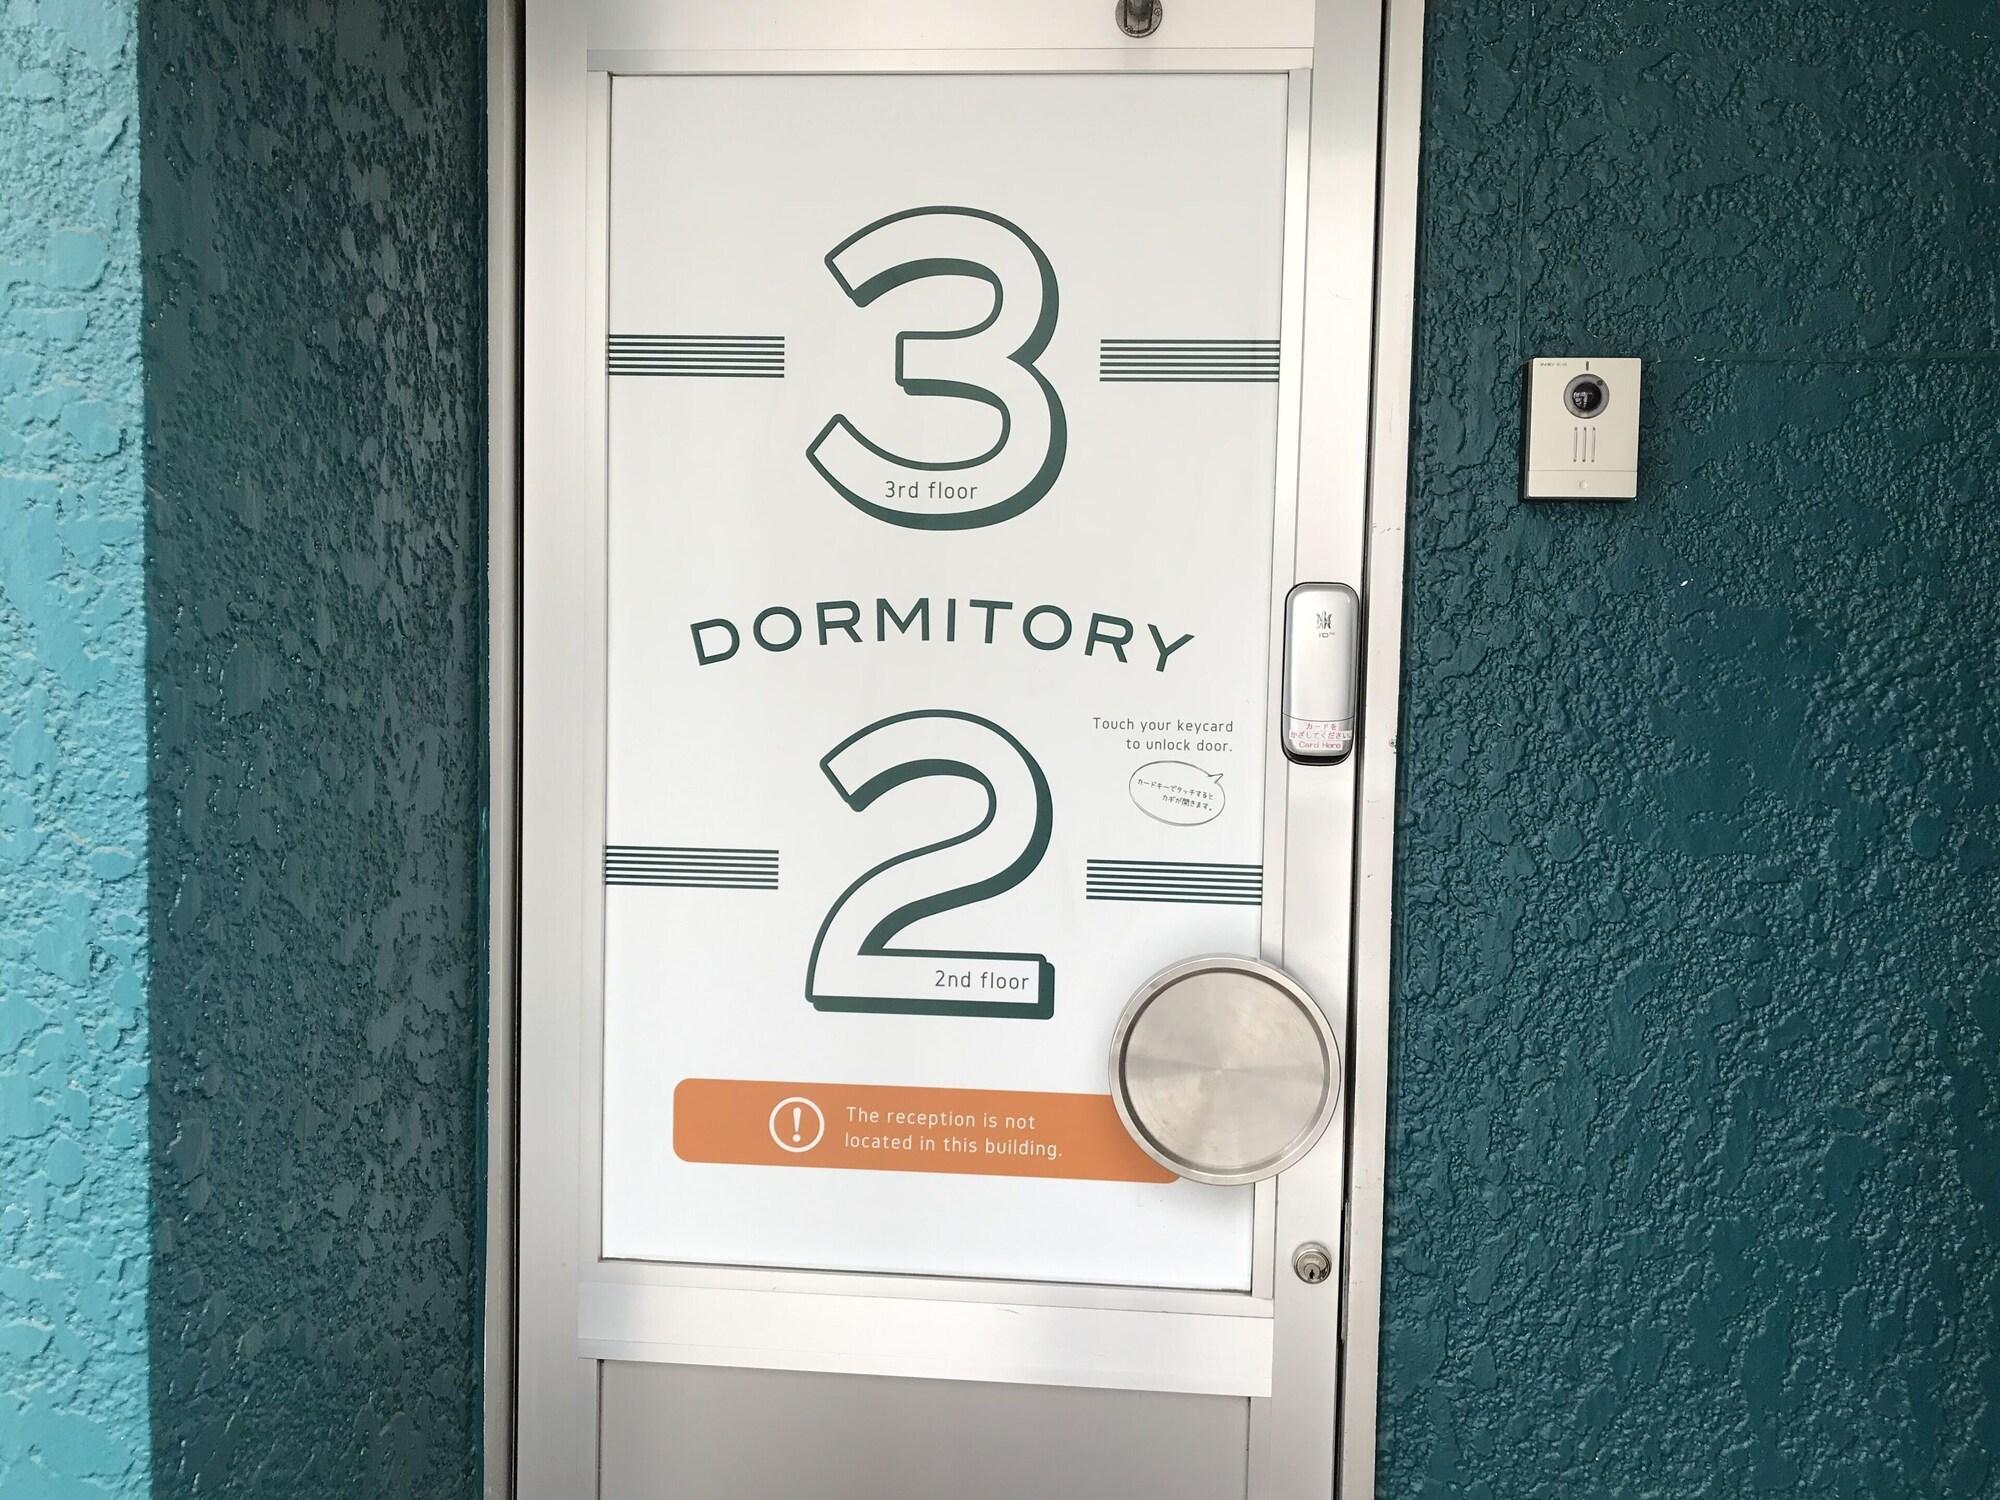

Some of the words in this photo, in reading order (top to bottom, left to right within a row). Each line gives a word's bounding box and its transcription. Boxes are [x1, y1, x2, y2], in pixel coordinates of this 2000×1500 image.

[806, 205, 1067, 532] 3
[884, 480, 919, 499] 3rd
[928, 481, 978, 500] floor
[690, 597, 1195, 673] DORMITORY
[1092, 716, 1135, 730] Touch
[1140, 721, 1172, 733] your
[1177, 719, 1233, 735] keycard
[1126, 738, 1141, 750] to
[1146, 738, 1191, 751] unlock
[1196, 739, 1233, 752] door.
[805, 709, 1056, 1021] 2
[935, 969, 971, 988] 2nd
[980, 971, 1030, 990] floor
[846, 1106, 880, 1123] The
[887, 1111, 976, 1129] reception
[983, 1112, 998, 1128] is
[1005, 1115, 1036, 1130] not
[844, 1131, 913, 1150] located
[920, 1135, 935, 1151] in
[943, 1135, 978, 1153] this
[985, 1137, 1063, 1161] building.
